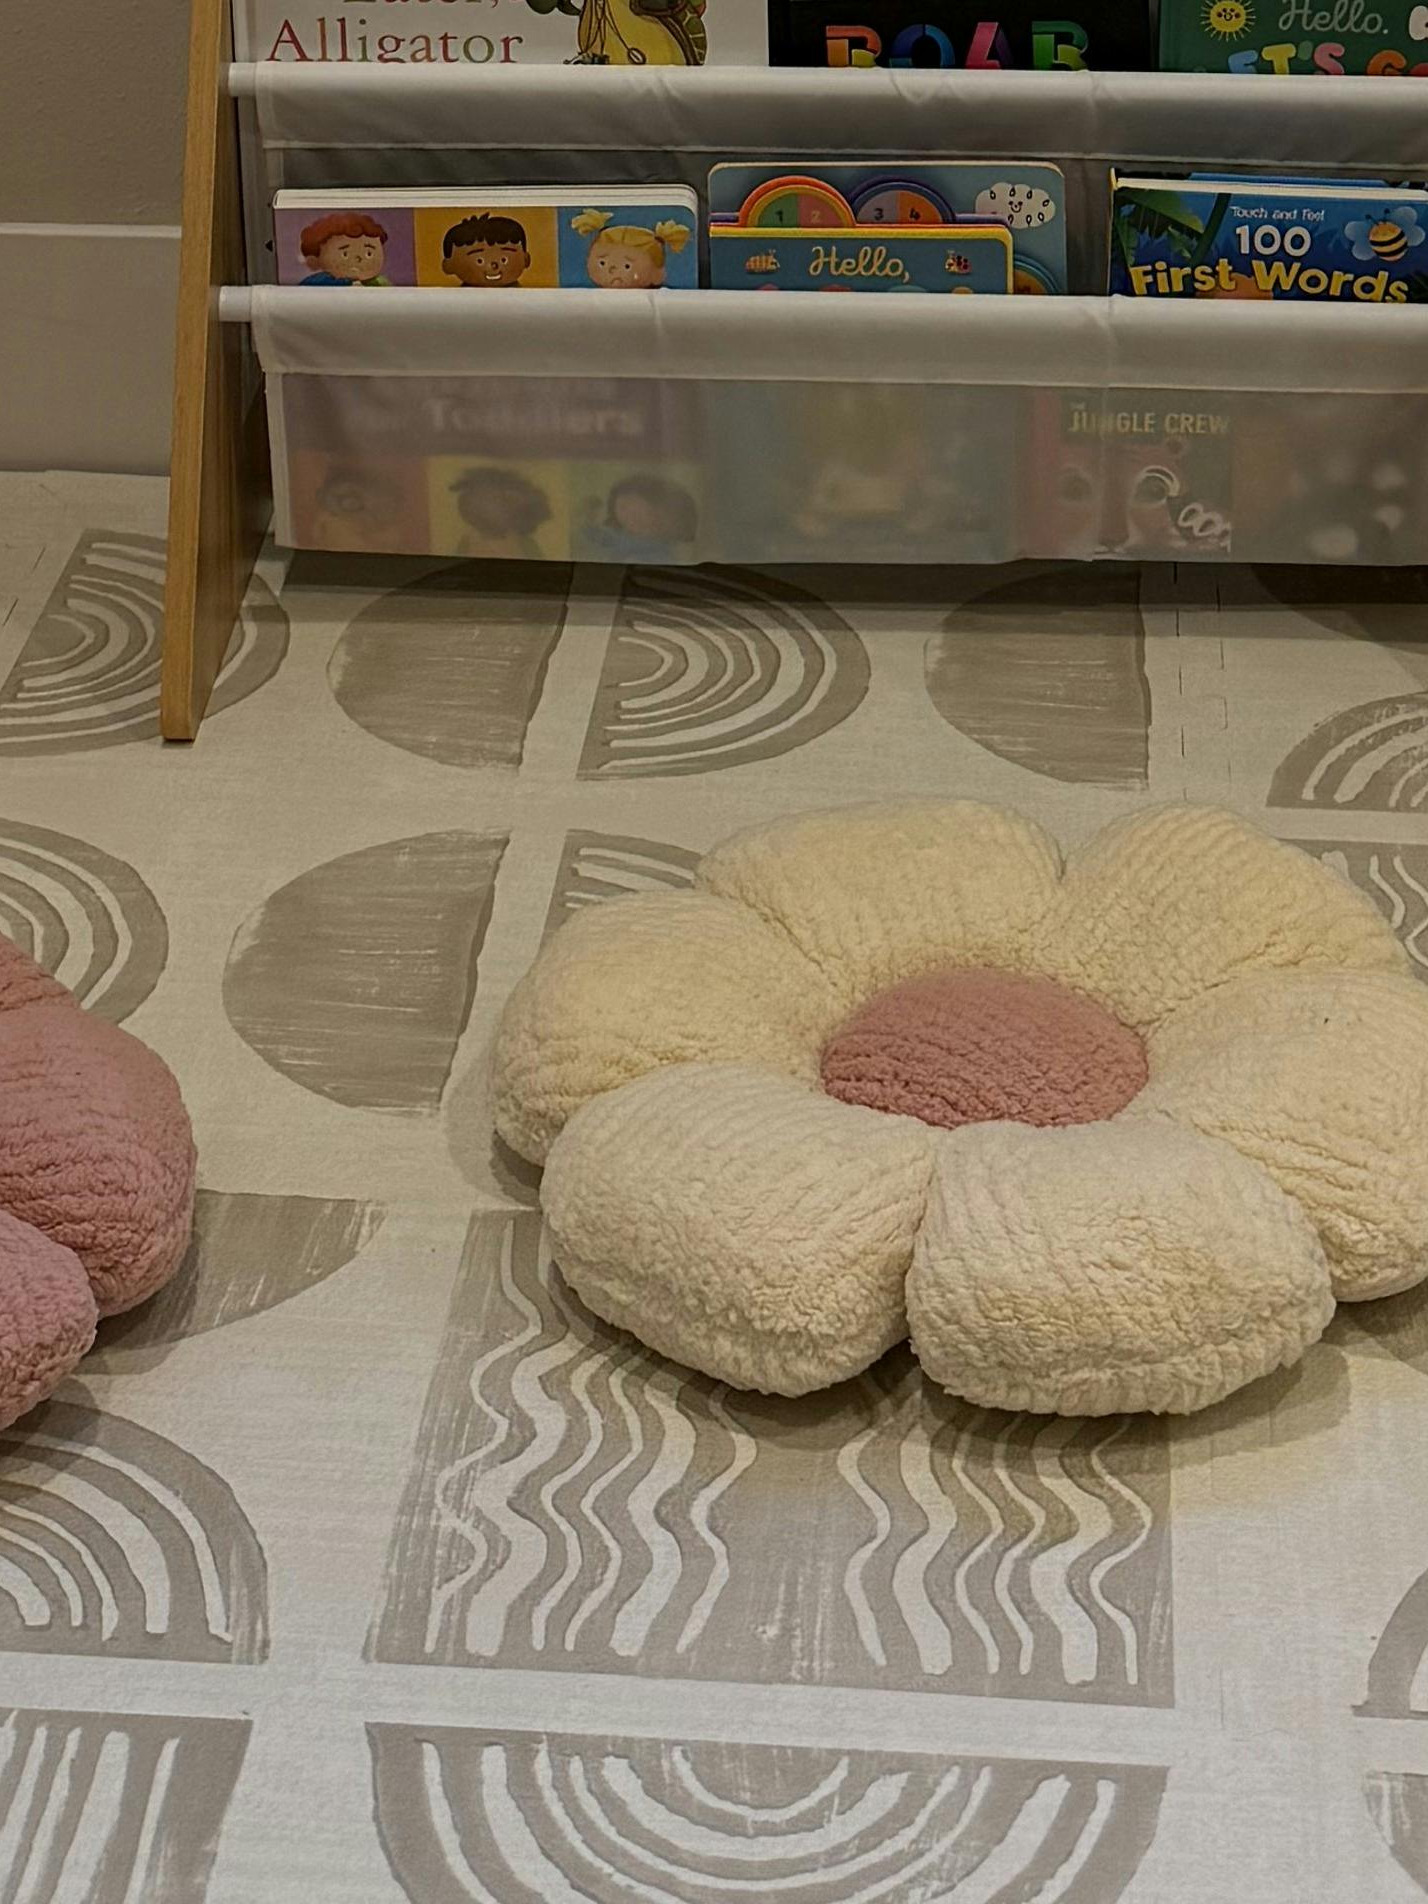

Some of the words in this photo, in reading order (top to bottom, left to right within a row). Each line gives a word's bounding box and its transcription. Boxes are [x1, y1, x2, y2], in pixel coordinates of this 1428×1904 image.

[264, 16, 525, 64] Alligator
[774, 210, 784, 223] 1
[811, 210, 821, 224] 2
[874, 208, 884, 221] 3
[909, 207, 921, 221] 4
[1229, 205, 1268, 219] Touch
[1272, 209, 1298, 220] and
[1301, 207, 1326, 221] Feel
[1235, 224, 1312, 257] 100
[809, 245, 911, 283] Hello,
[1128, 258, 1237, 296] First
[1251, 259, 1409, 303] Words
[1164, 411, 1230, 434] CREW
